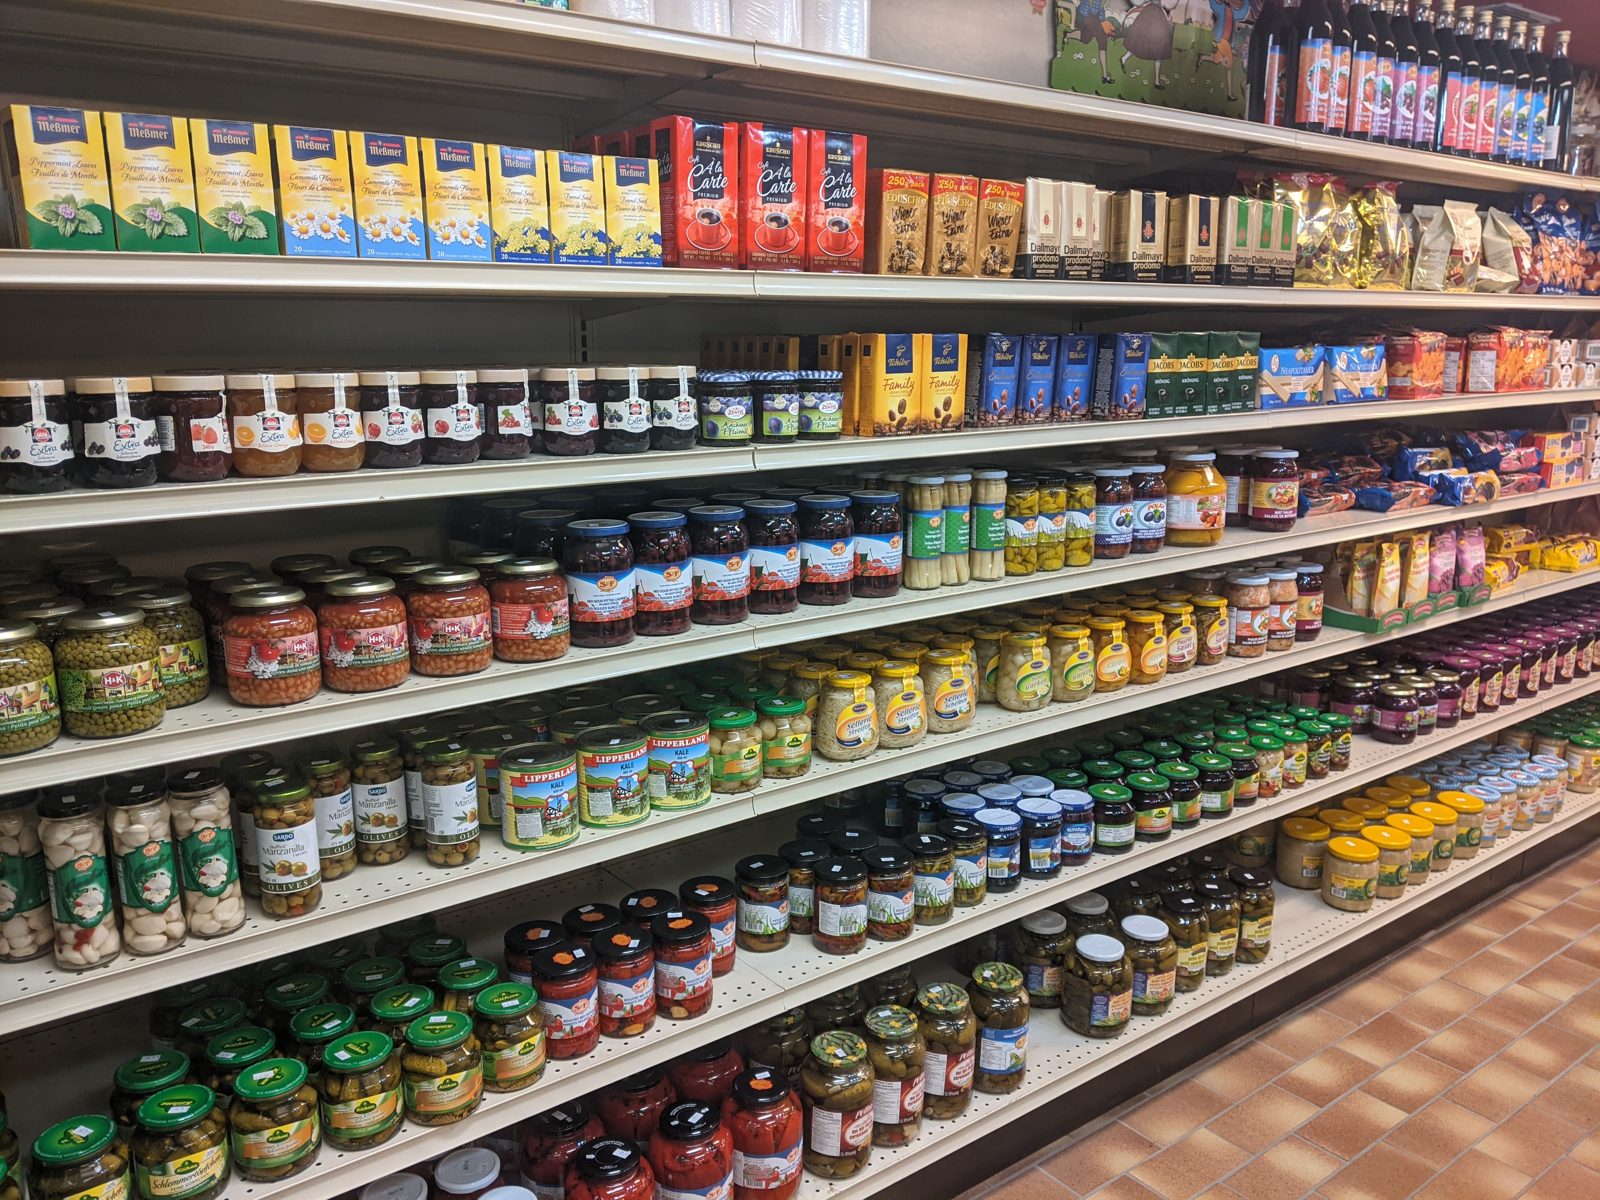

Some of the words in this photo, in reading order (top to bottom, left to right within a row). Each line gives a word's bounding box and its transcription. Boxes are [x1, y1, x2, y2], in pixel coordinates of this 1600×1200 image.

[37, 121, 80, 134] Meßmer
[128, 128, 168, 140] Meßmer
[212, 133, 250, 145] Meßmer
[296, 139, 330, 151] Meßmer
[369, 146, 402, 157] Meßmer
[766, 147, 791, 155] EDUSCHO
[440, 152, 470, 163] Meßmer
[688, 154, 700, 164] Café
[30, 158, 72, 168] Peppermint
[72, 160, 97, 169] Leaves
[120, 162, 159, 173] Peppermint
[504, 158, 532, 169] Meßmer
[702, 158, 713, 175] À
[714, 162, 723, 173] la
[758, 161, 769, 170] Café
[204, 168, 241, 177] Peppermint
[241, 170, 264, 178] Leaves
[563, 164, 590, 174] Meßmer
[619, 168, 646, 178] Meßmer
[771, 163, 782, 180] À
[784, 166, 792, 178] la
[31, 169, 60, 178] Feuilles
[69, 172, 98, 180] Menthe
[122, 174, 148, 182] Feuilles
[157, 176, 184, 184] Menthe
[318, 175, 342, 183] Flowers
[688, 164, 728, 192] Carte
[833, 169, 844, 185] À
[844, 172, 852, 182] la
[206, 177, 230, 187] Feuilles
[239, 180, 265, 188] Menthe
[287, 183, 308, 191] Fleurs
[757, 169, 797, 196] Carte
[819, 175, 856, 201] Carte
[1007, 190, 1020, 198] pack
[887, 194, 926, 206] EDUSCHO
[984, 200, 1019, 213] EDUSCHO
[1030, 242, 1060, 254] Dallmayr
[1064, 245, 1092, 257] Dallmayr
[1033, 255, 1059, 264] prodomo
[1066, 256, 1092, 265] prodomo
[1132, 252, 1162, 262] Dallmayr
[1190, 254, 1216, 265] Dallmayr
[1252, 256, 1275, 266] Dallmayr
[1134, 262, 1161, 271] prodomo
[1191, 264, 1214, 273] prodomo
[1230, 265, 1249, 273] Classic
[1254, 266, 1272, 274] Classic
[1275, 268, 1293, 276] Classic
[994, 352, 1014, 361] Tchibo
[1032, 352, 1051, 361] Tchibo
[1068, 351, 1087, 359] Tchibo
[1125, 349, 1144, 357] Tchibo
[888, 358, 911, 367] Tchibo
[934, 357, 957, 365] Tchibo
[1152, 362, 1174, 370] JACOBS
[1179, 360, 1204, 369] JACOBS
[1211, 361, 1234, 369] JACOBS
[1280, 366, 1314, 375] NEAPOLITANER
[883, 376, 915, 397] Family
[929, 375, 960, 395] Family
[567, 419, 586, 428] Extra
[627, 416, 644, 425] Extra
[677, 414, 692, 423] Extra
[386, 427, 409, 437] Extra
[454, 424, 475, 433] Extra
[260, 432, 285, 443] Extra
[332, 430, 354, 440] Extra
[30, 444, 57, 456] Extra
[114, 440, 140, 452] Extra
[369, 635, 384, 643] H&K
[293, 643, 307, 651] H&K
[104, 676, 124, 684] H&K
[652, 735, 706, 747] LIPPERLAND
[596, 747, 648, 763] LIPPERLAN
[524, 764, 576, 783] LIPPERLAN
[550, 780, 565, 789] KALE
[368, 787, 387, 795] SARDO
[358, 798, 396, 808] Manzanilla
[274, 832, 294, 840] SARDO
[362, 830, 399, 841] OLIVES
[263, 844, 305, 856] Manzanilla
[268, 880, 308, 891] OLIVES
[152, 1154, 223, 1189] Schlemmertöpfchen
